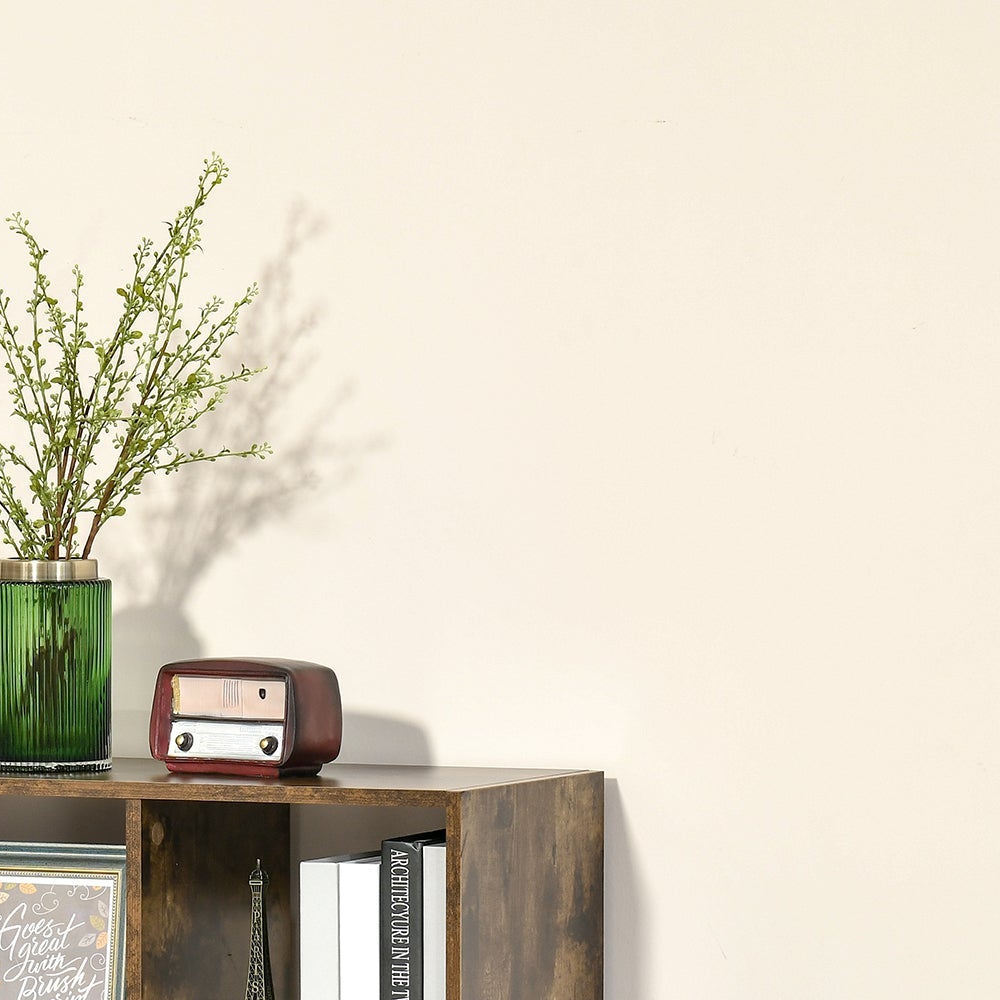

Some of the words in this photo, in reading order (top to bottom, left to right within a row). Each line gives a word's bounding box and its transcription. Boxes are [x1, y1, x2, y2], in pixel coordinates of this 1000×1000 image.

[391, 849, 409, 944] ARCHITECYURE
[3, 914, 85, 982] great
[391, 947, 409, 960] IN
[28, 953, 81, 976] with
[391, 963, 409, 987] THE
